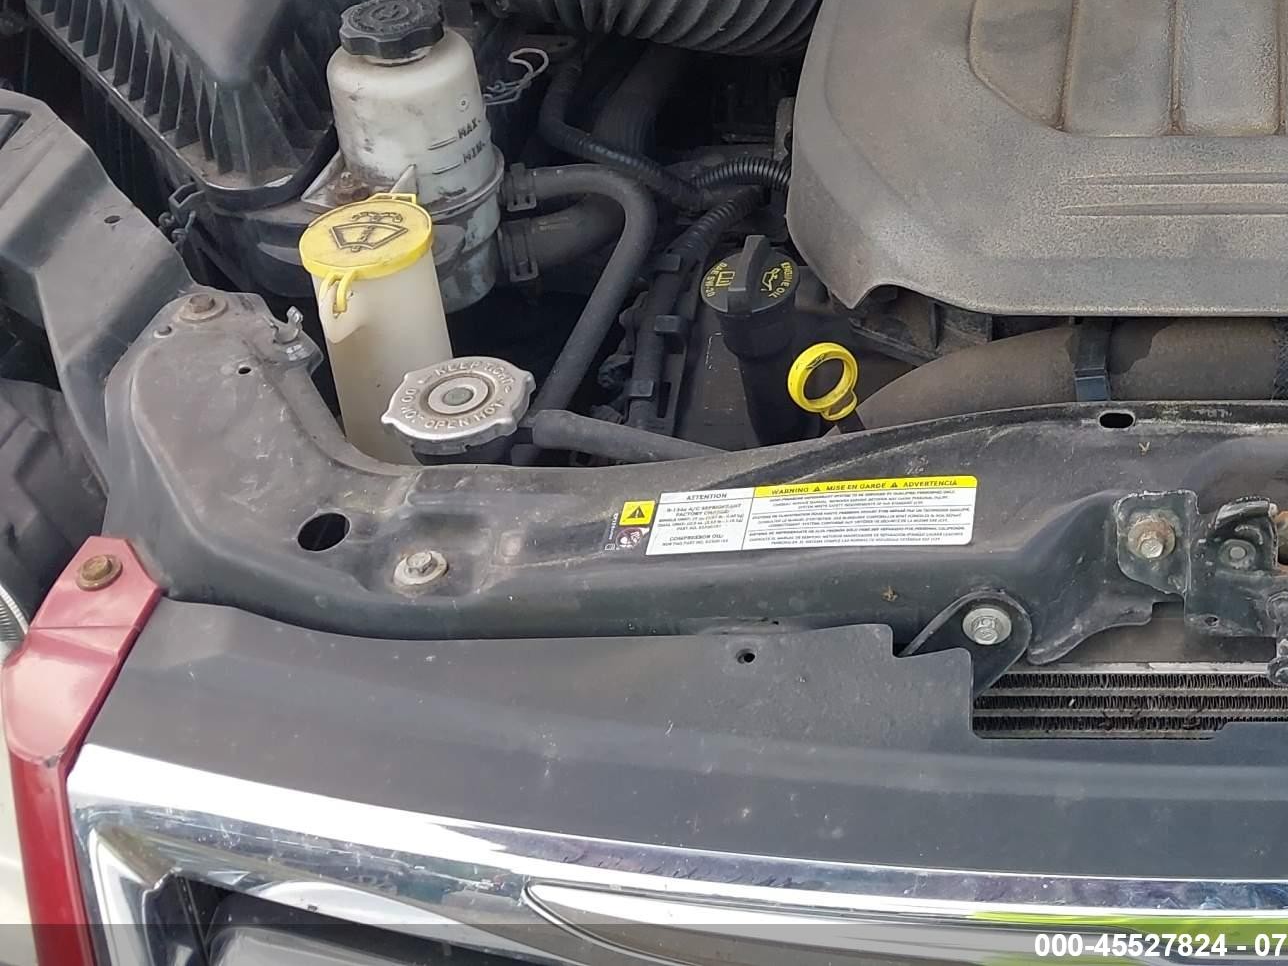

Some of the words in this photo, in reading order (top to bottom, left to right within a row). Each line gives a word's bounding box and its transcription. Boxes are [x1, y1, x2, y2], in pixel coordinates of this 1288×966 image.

[768, 287, 786, 299] OIL
[434, 362, 480, 377] KEEP
[400, 388, 417, 403] DO
[424, 417, 470, 430] OPEN
[474, 399, 506, 422] HOT
[772, 487, 809, 495] WARNING
[903, 480, 958, 488] ADVERTENCIA
[686, 493, 727, 501] ATTENTION
